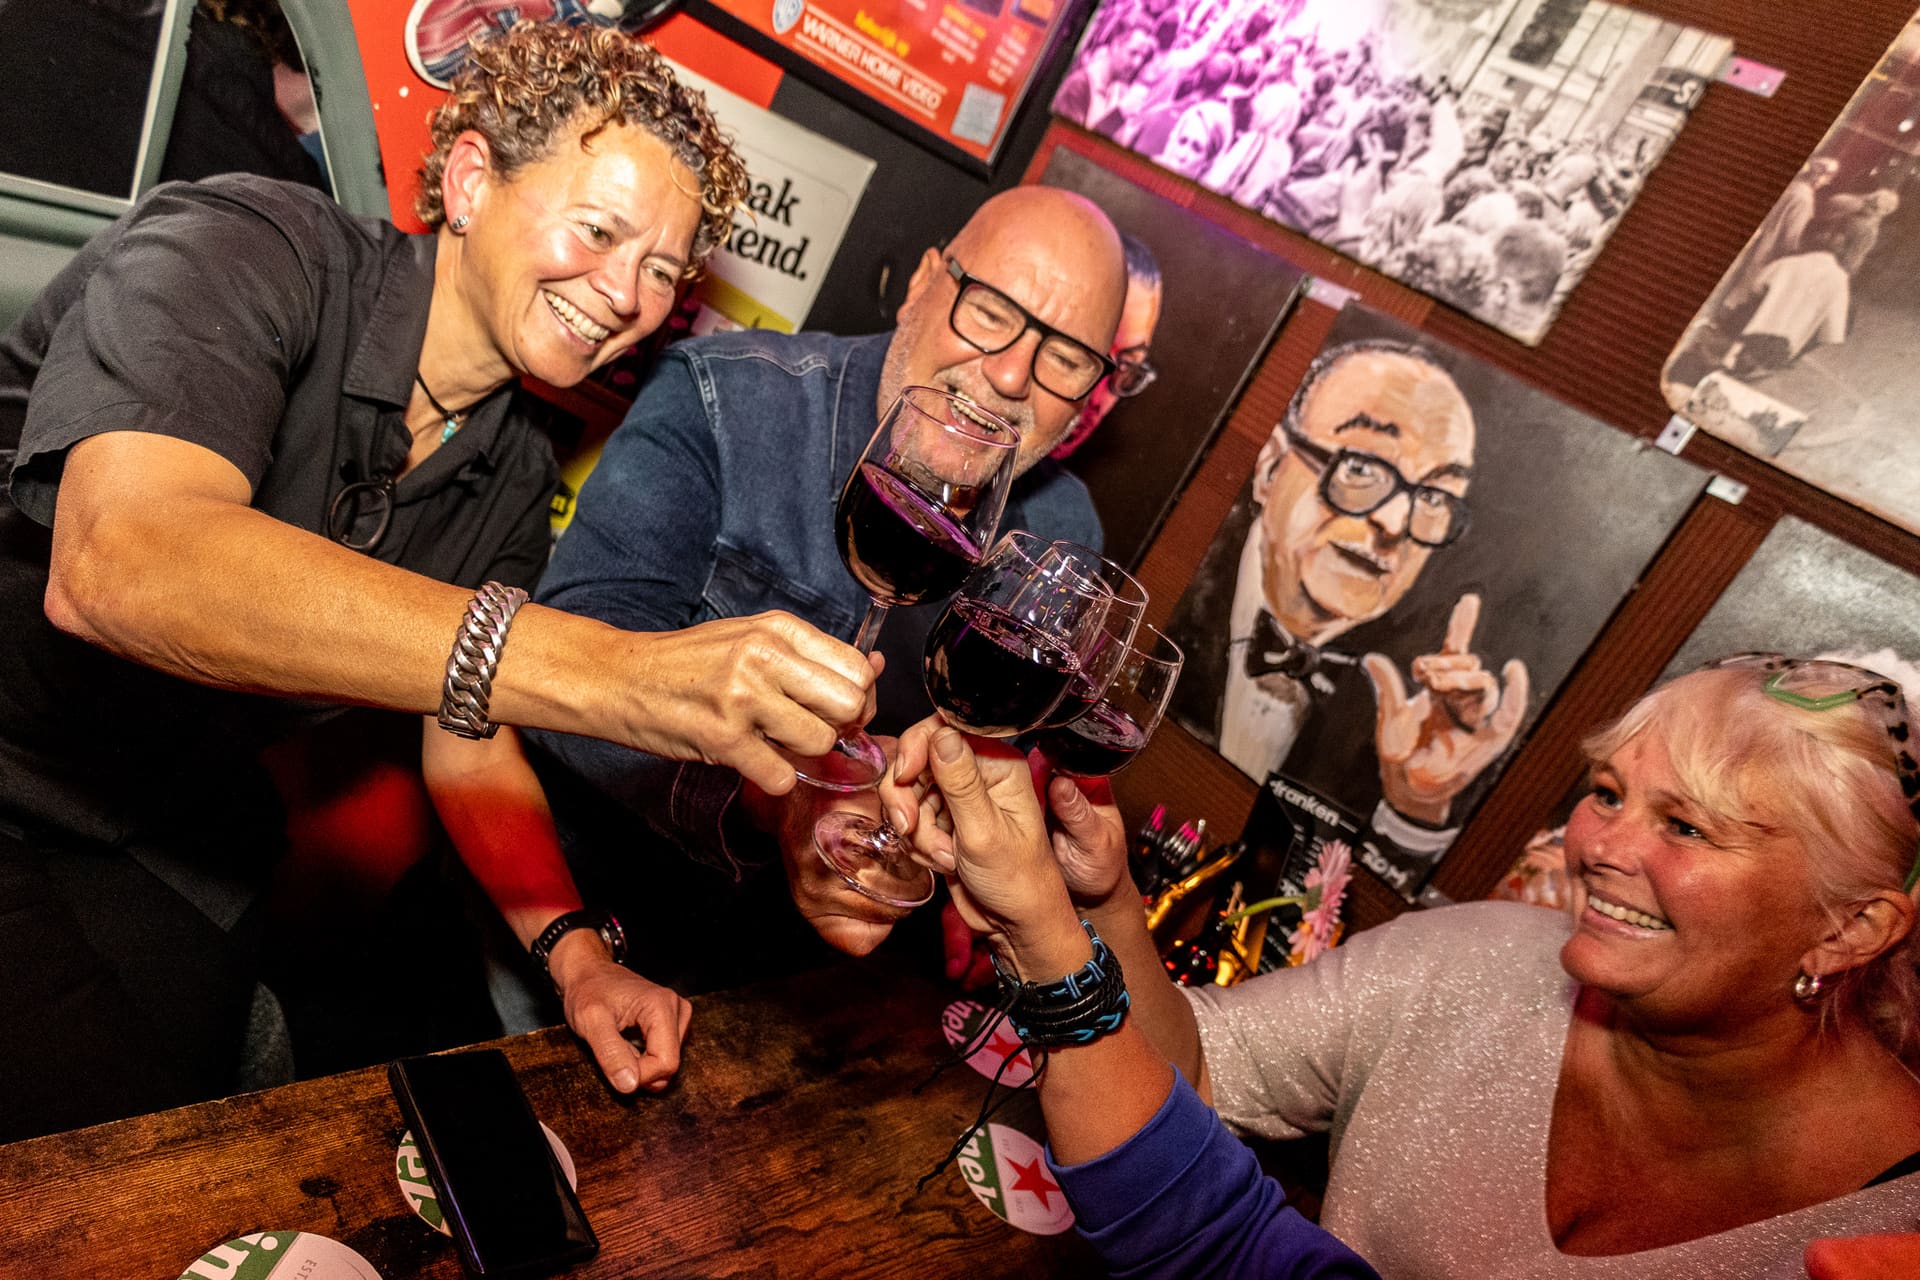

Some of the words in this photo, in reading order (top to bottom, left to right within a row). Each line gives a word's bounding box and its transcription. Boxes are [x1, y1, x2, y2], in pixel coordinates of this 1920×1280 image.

[803, 14, 861, 63] WARNER
[860, 50, 902, 88] HOME
[901, 75, 942, 110] VIDEO
